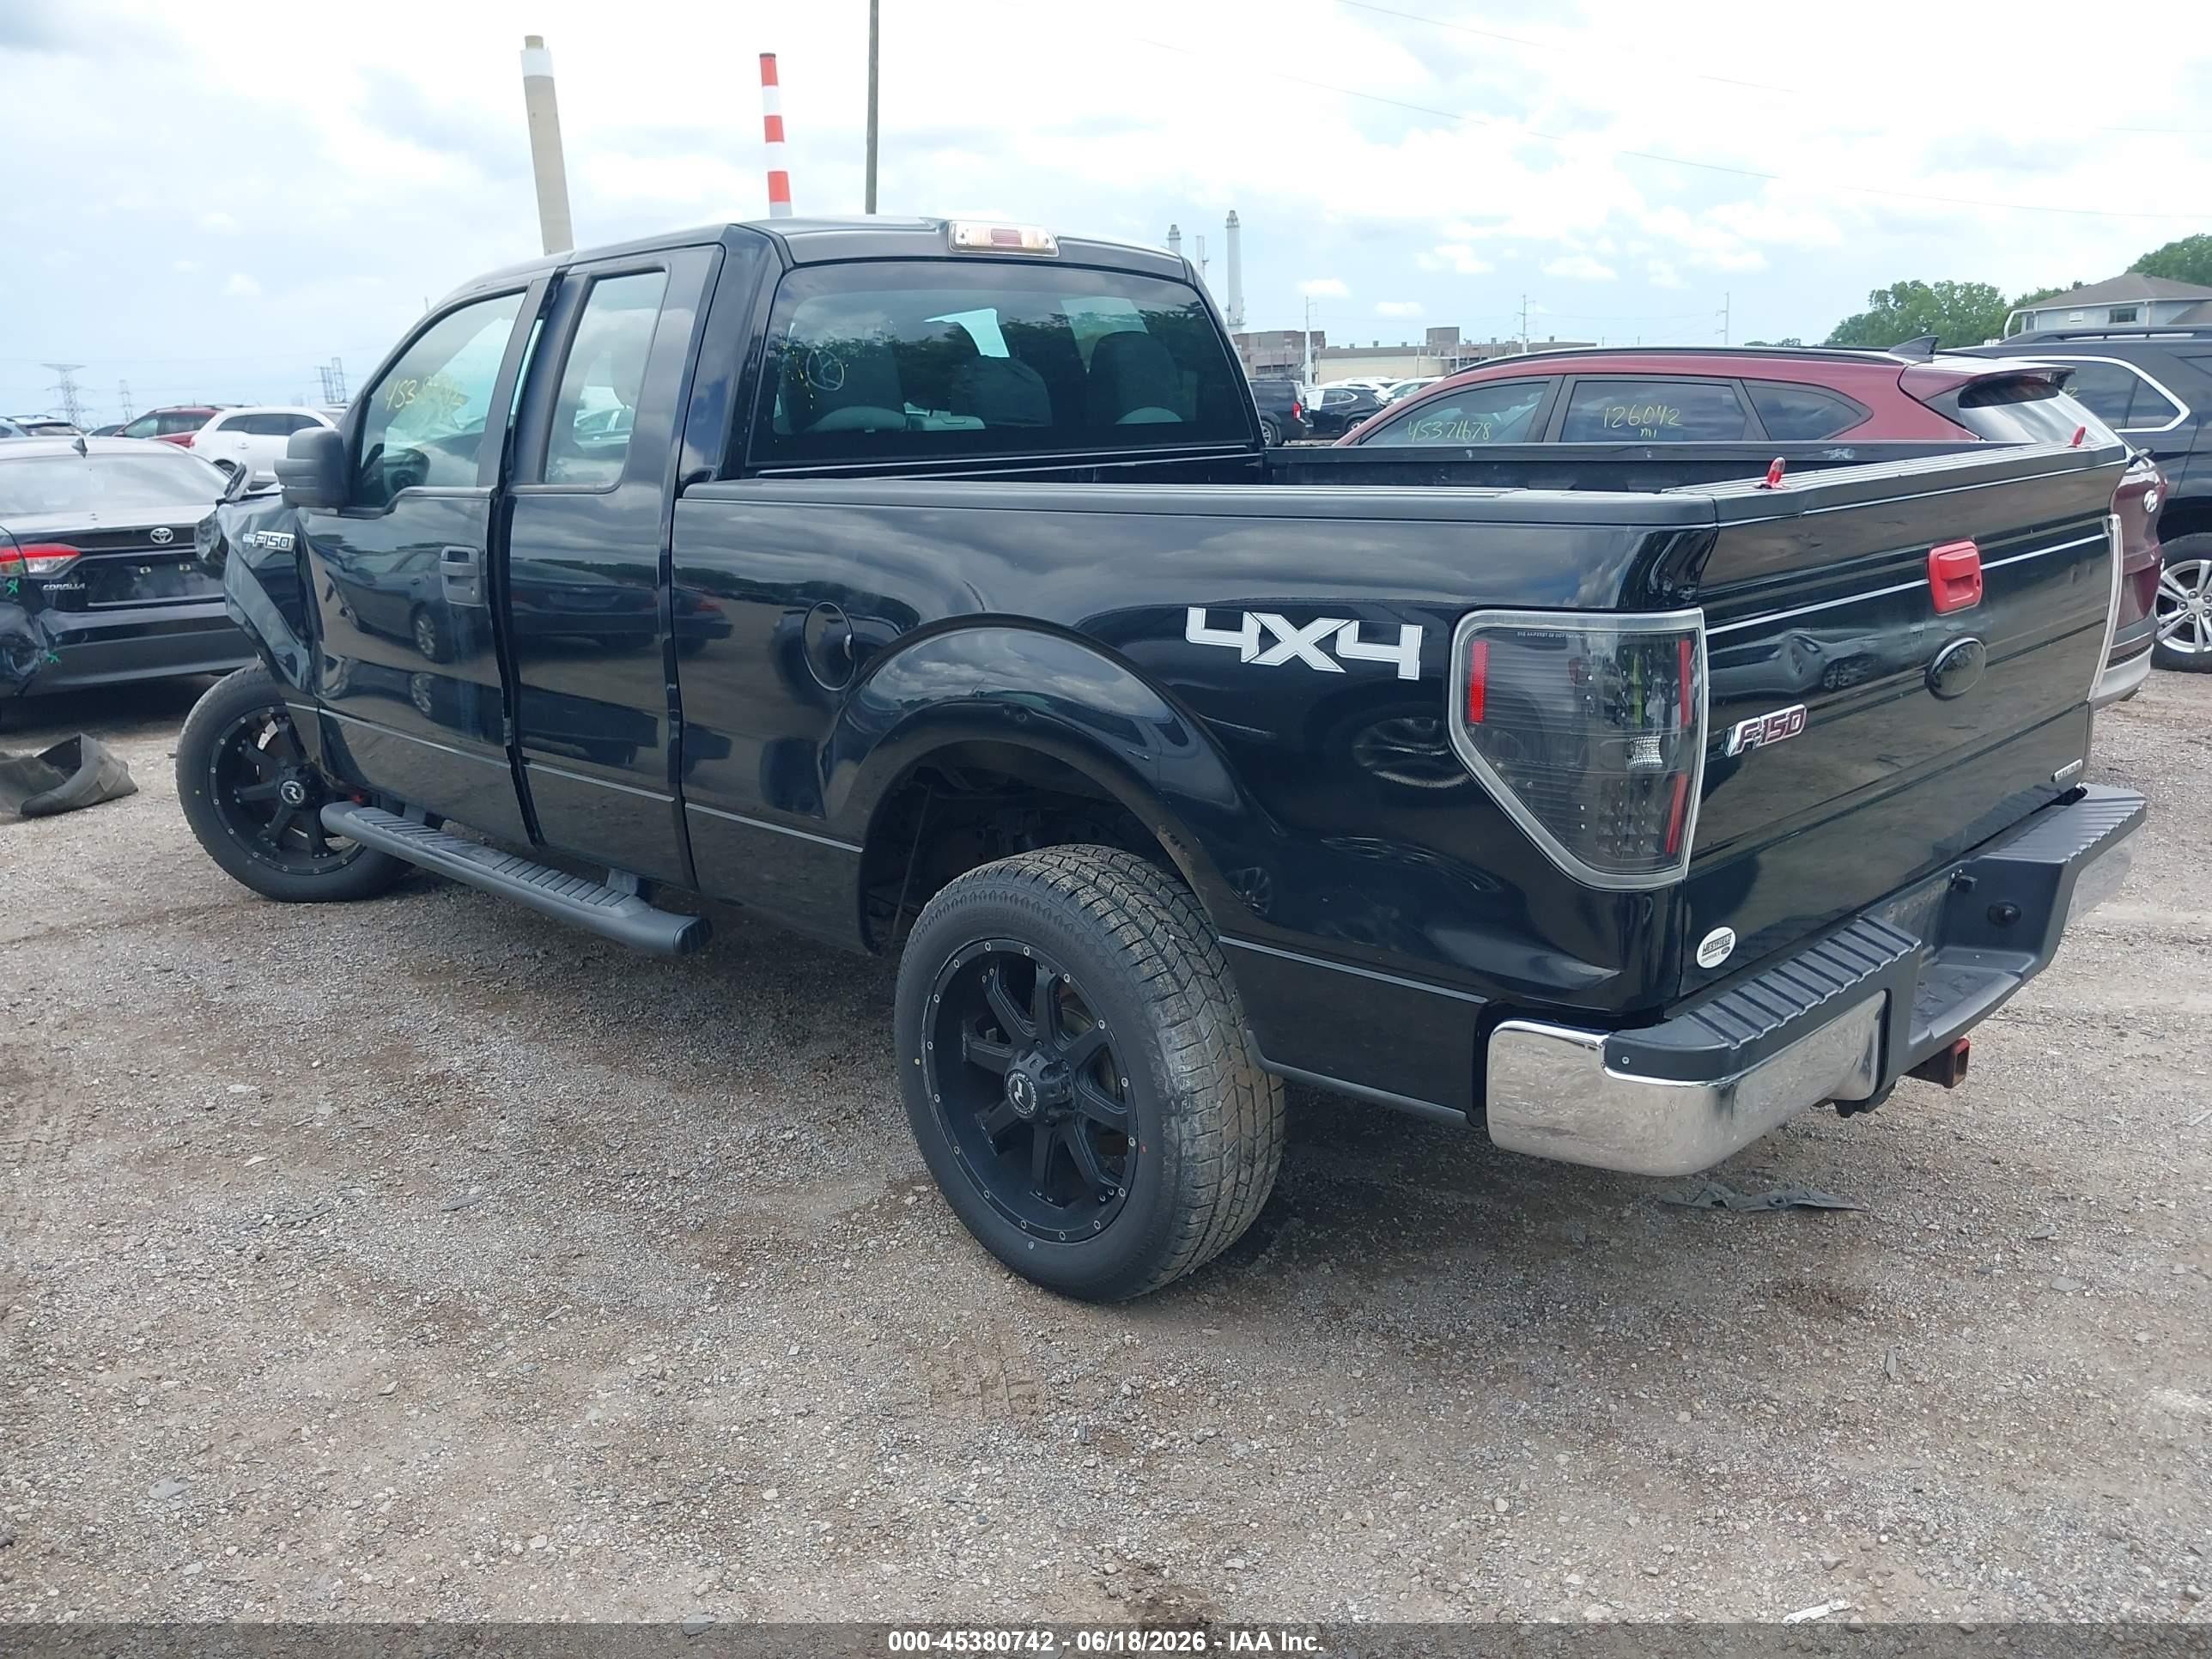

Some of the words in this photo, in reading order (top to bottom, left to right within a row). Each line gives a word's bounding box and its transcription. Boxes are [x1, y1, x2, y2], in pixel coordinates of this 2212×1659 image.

[1408, 419, 1492, 443] 45371678
[42, 582, 85, 591] COROLLA
[1702, 933, 1732, 956] WESTFIELD
